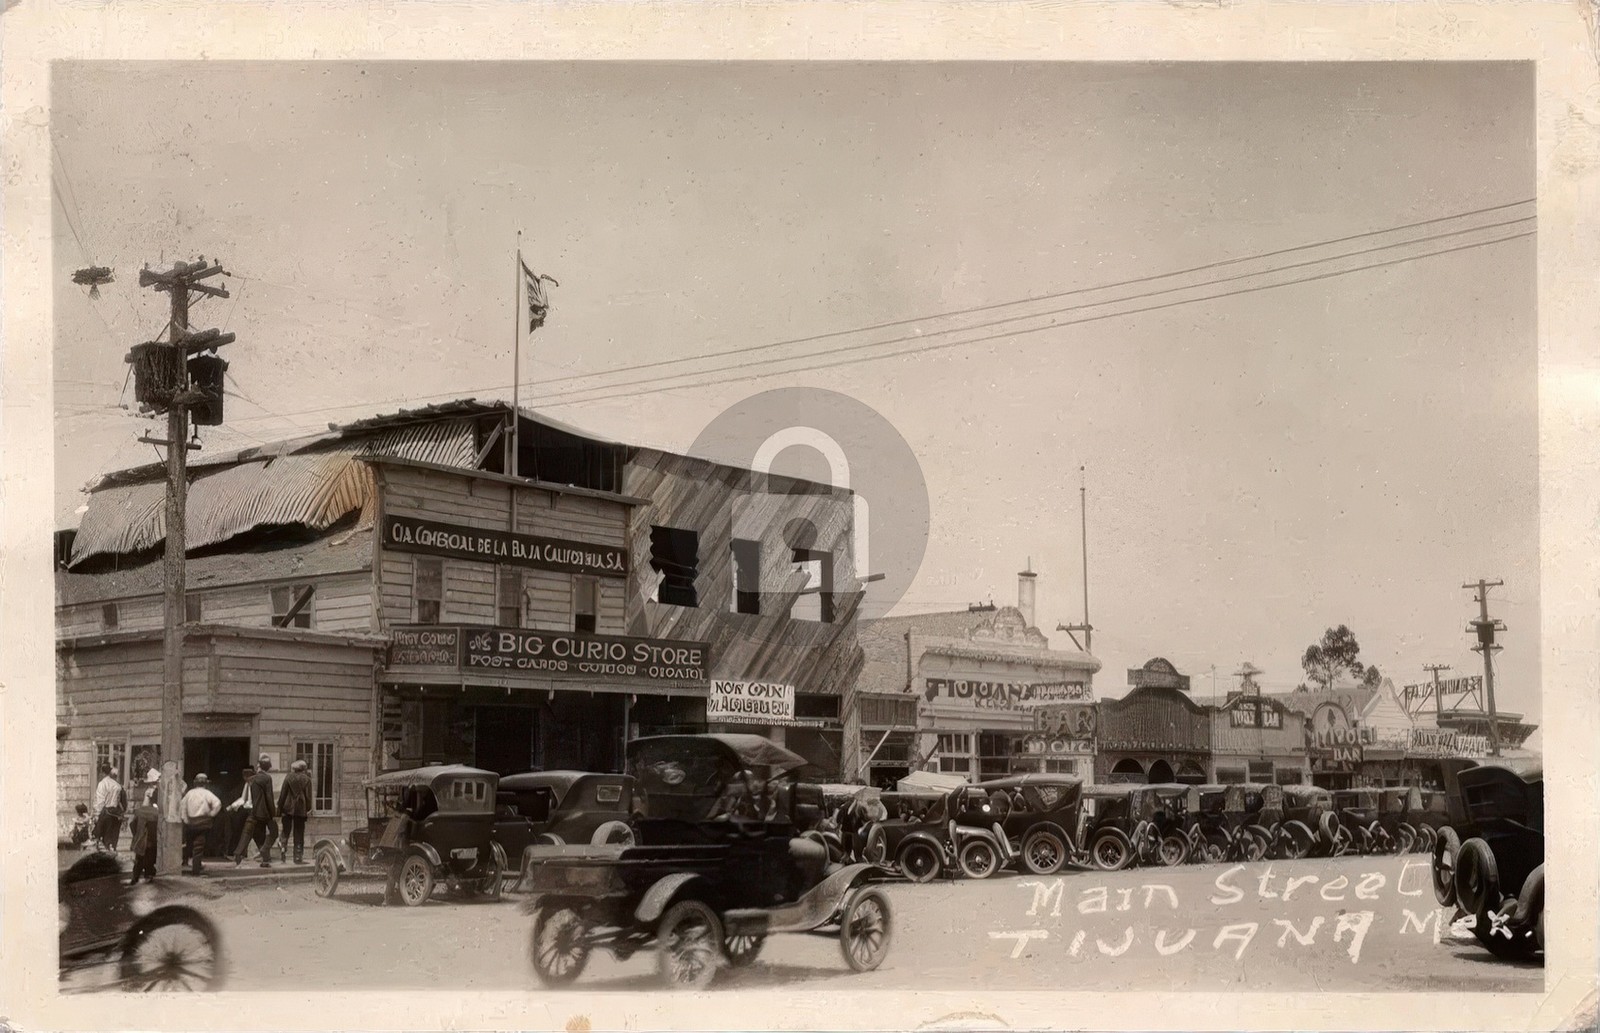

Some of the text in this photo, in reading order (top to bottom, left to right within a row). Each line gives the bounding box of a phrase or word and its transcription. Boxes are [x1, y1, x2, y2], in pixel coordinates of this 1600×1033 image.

[493, 539, 508, 556] LA
[498, 632, 546, 655] BIG
[551, 637, 627, 661] CURIO
[632, 642, 702, 666] STORE
